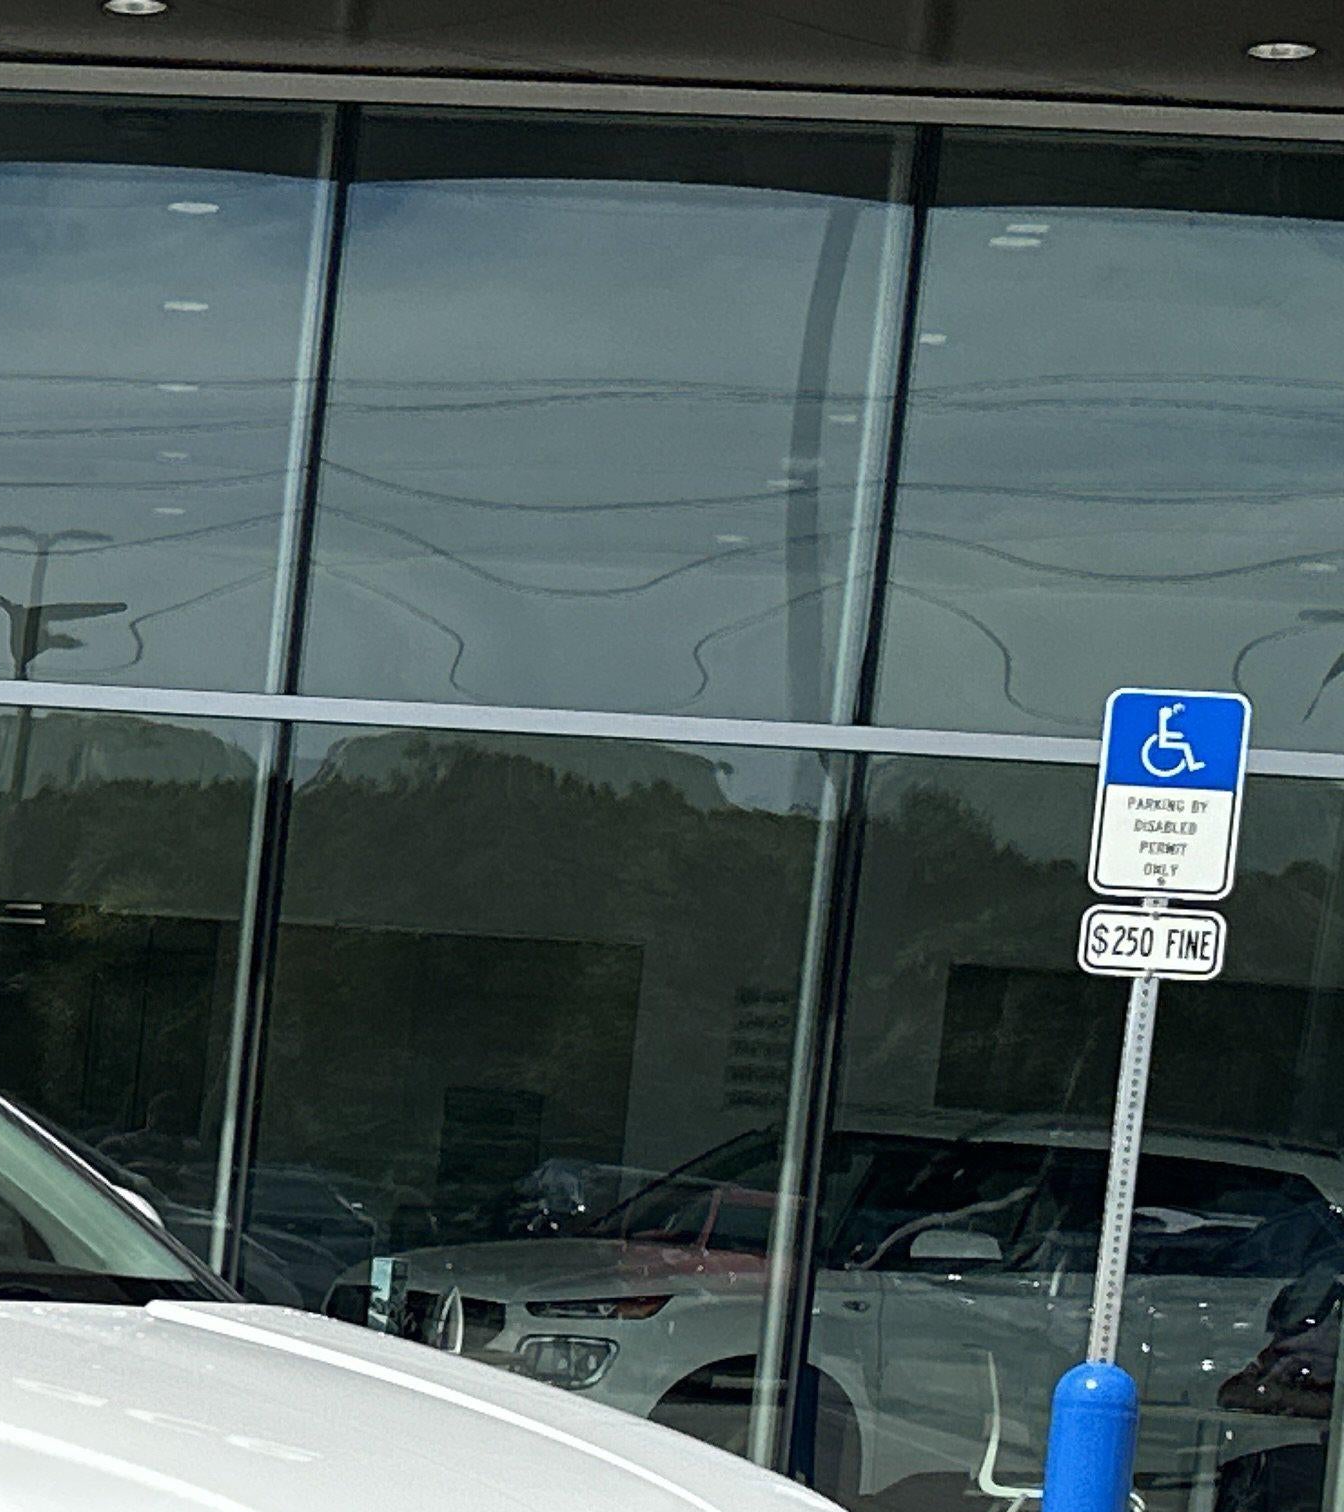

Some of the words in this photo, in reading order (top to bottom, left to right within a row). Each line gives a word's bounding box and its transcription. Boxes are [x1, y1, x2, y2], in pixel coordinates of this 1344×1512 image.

[1127, 797, 1185, 813] PARKING
[1191, 800, 1208, 814] BY
[1133, 819, 1197, 835] DISABLED
[1138, 842, 1187, 856] PERMIT
[1144, 863, 1178, 877] ONLY
[1091, 924, 1154, 958] $250
[1166, 929, 1212, 960] FINE
